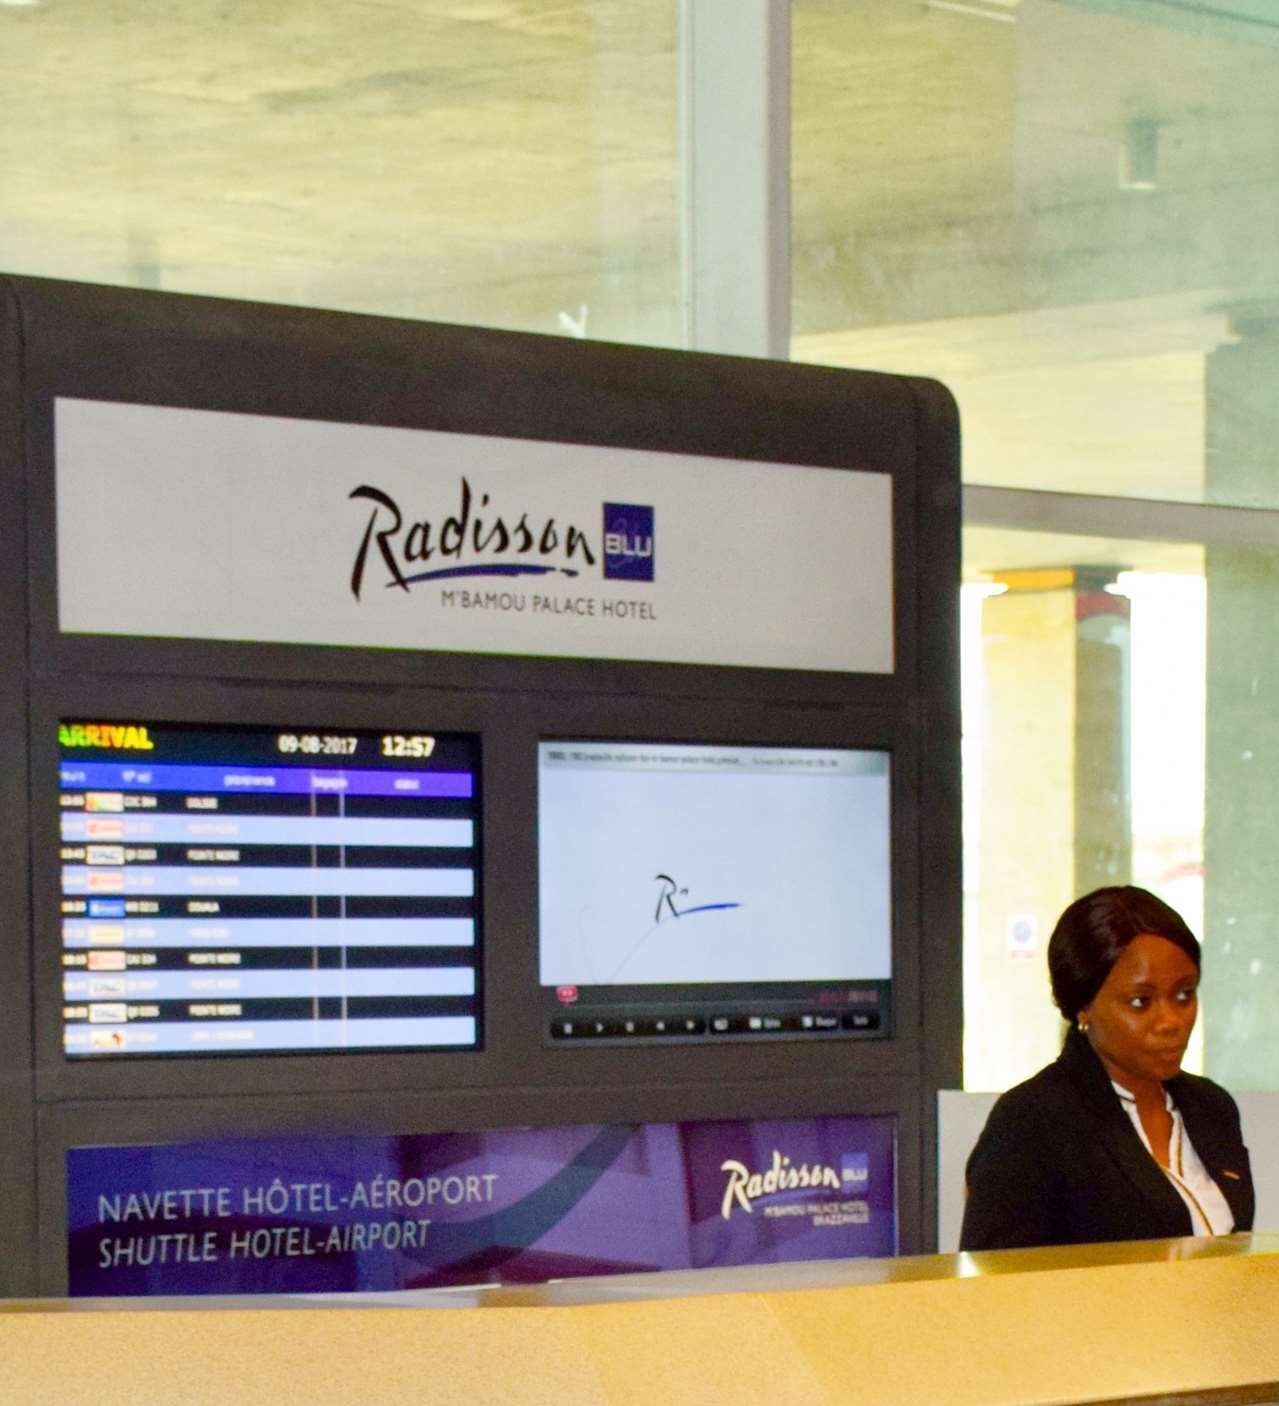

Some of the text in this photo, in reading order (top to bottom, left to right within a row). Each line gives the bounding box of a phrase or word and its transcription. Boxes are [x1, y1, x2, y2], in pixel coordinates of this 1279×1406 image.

[348, 476, 653, 603] Radisson BLU
[440, 590, 657, 621] M'BAMOU PALACE HOTEL
[58, 724, 154, 750] ARRIVAL
[382, 735, 436, 758] 12:57
[98, 1174, 498, 1223] NAVETTE HÔTEL-AÉROPORT
[721, 1150, 840, 1220] Radisson
[99, 1220, 432, 1269] SHUTTLE HOTEL-AIRPORT
